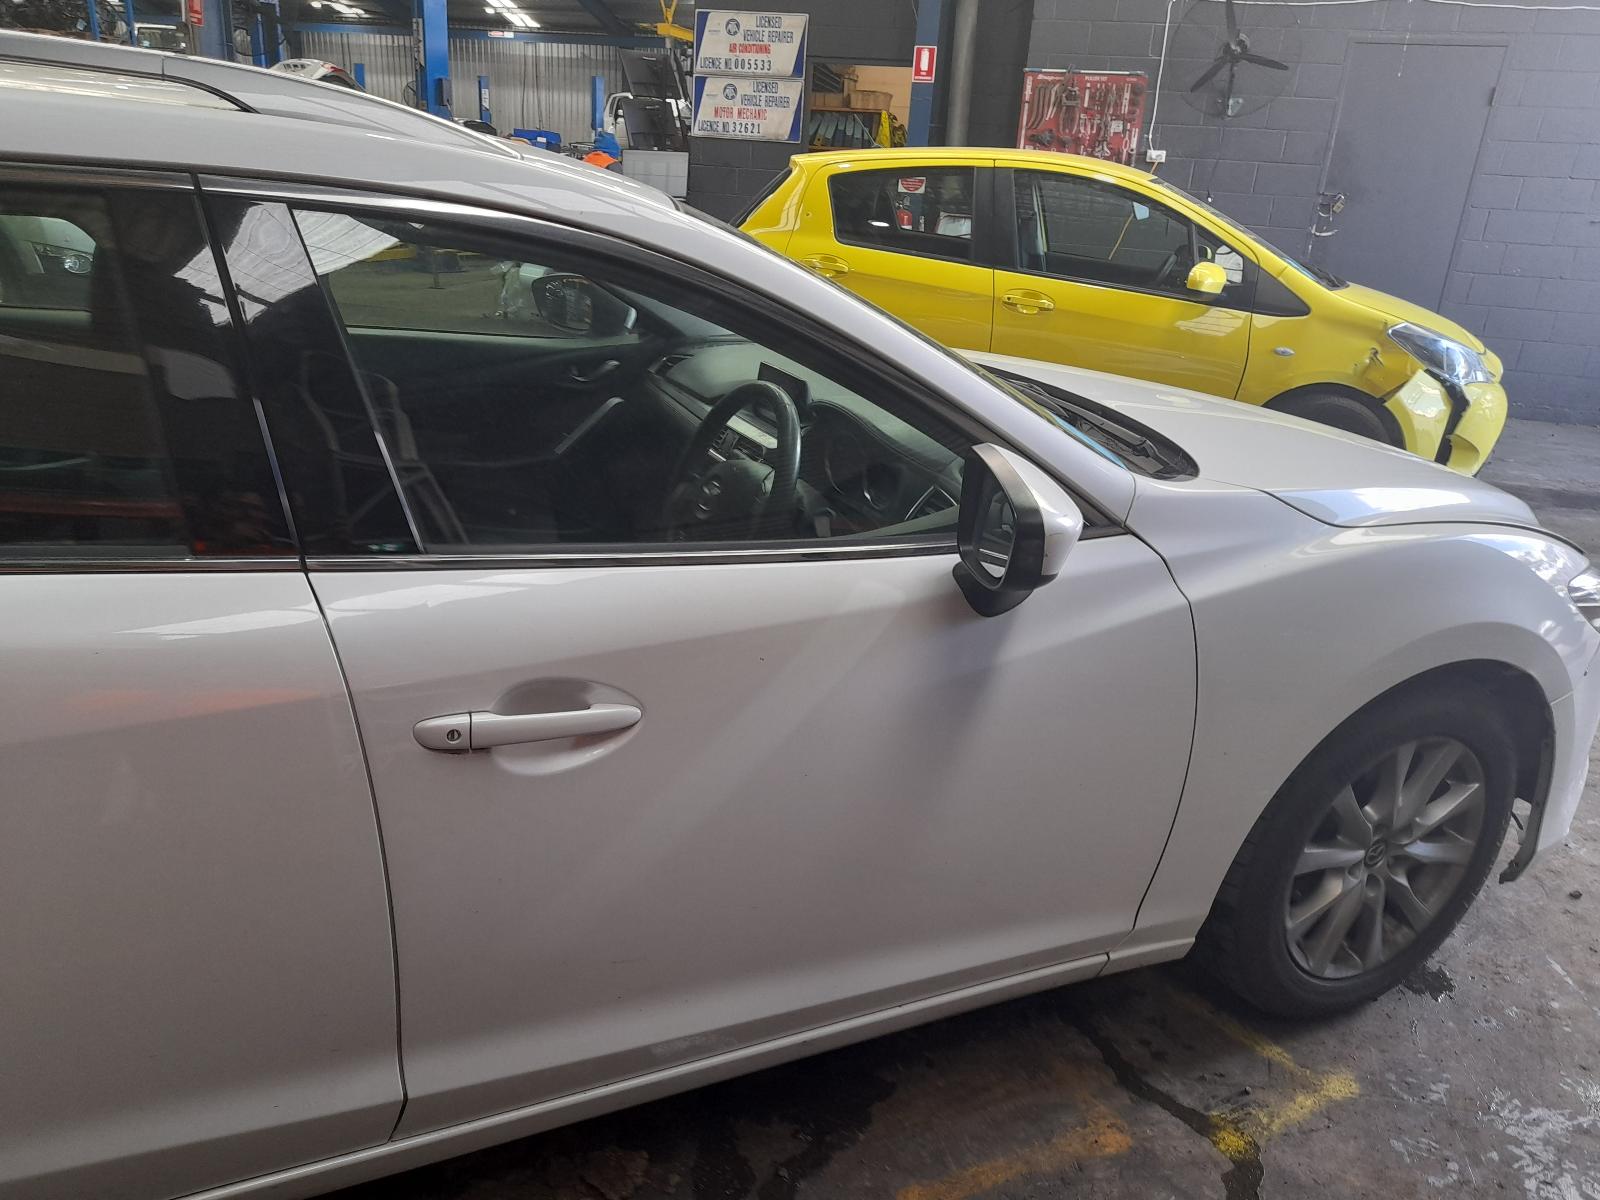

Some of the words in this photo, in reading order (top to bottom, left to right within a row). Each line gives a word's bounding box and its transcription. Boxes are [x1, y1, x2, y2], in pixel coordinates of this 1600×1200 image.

[755, 16, 783, 28] LICENSED
[743, 30, 765, 42] VEHICLE
[768, 31, 794, 43] REPAIRER
[738, 43, 771, 54] CONDITIONING
[734, 58, 772, 71] 005533
[753, 81, 778, 94] LICENSED
[740, 94, 762, 107] VEHICLE
[764, 96, 790, 108] REPAIRER
[714, 106, 734, 119] MOTOR
[737, 107, 768, 121] MECHANIC
[732, 121, 761, 134] 32621
